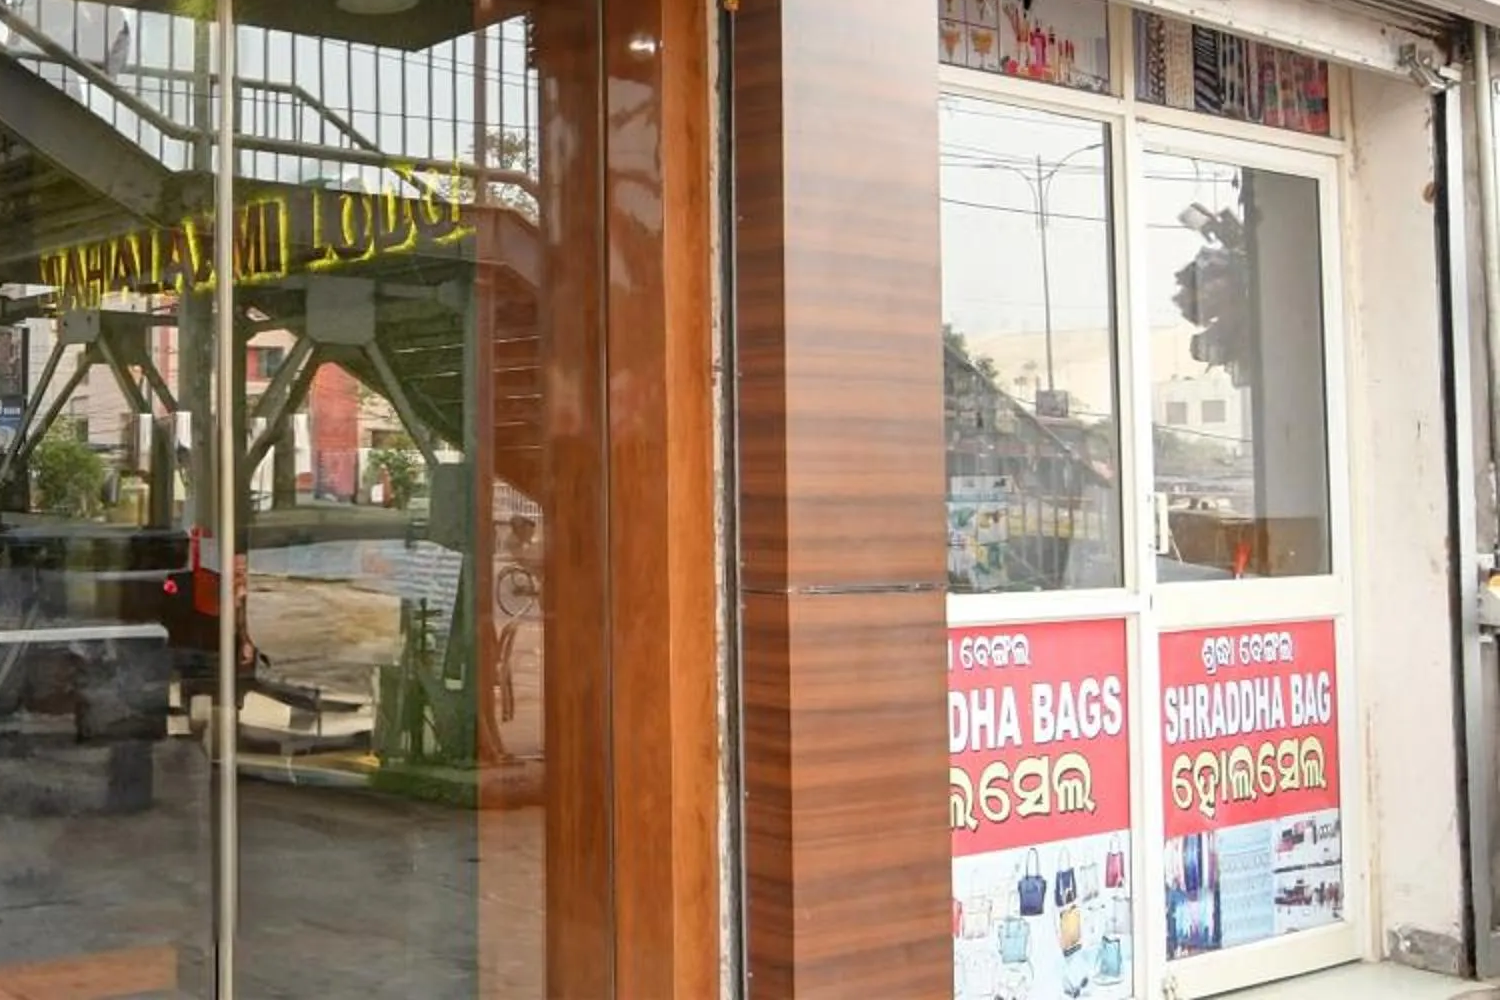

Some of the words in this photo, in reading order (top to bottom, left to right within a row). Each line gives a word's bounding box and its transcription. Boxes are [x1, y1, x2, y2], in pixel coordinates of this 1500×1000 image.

[1031, 675, 1123, 745] BAGS
[1164, 677, 1286, 745] SHRADDHA
[1289, 671, 1332, 727] BAG
